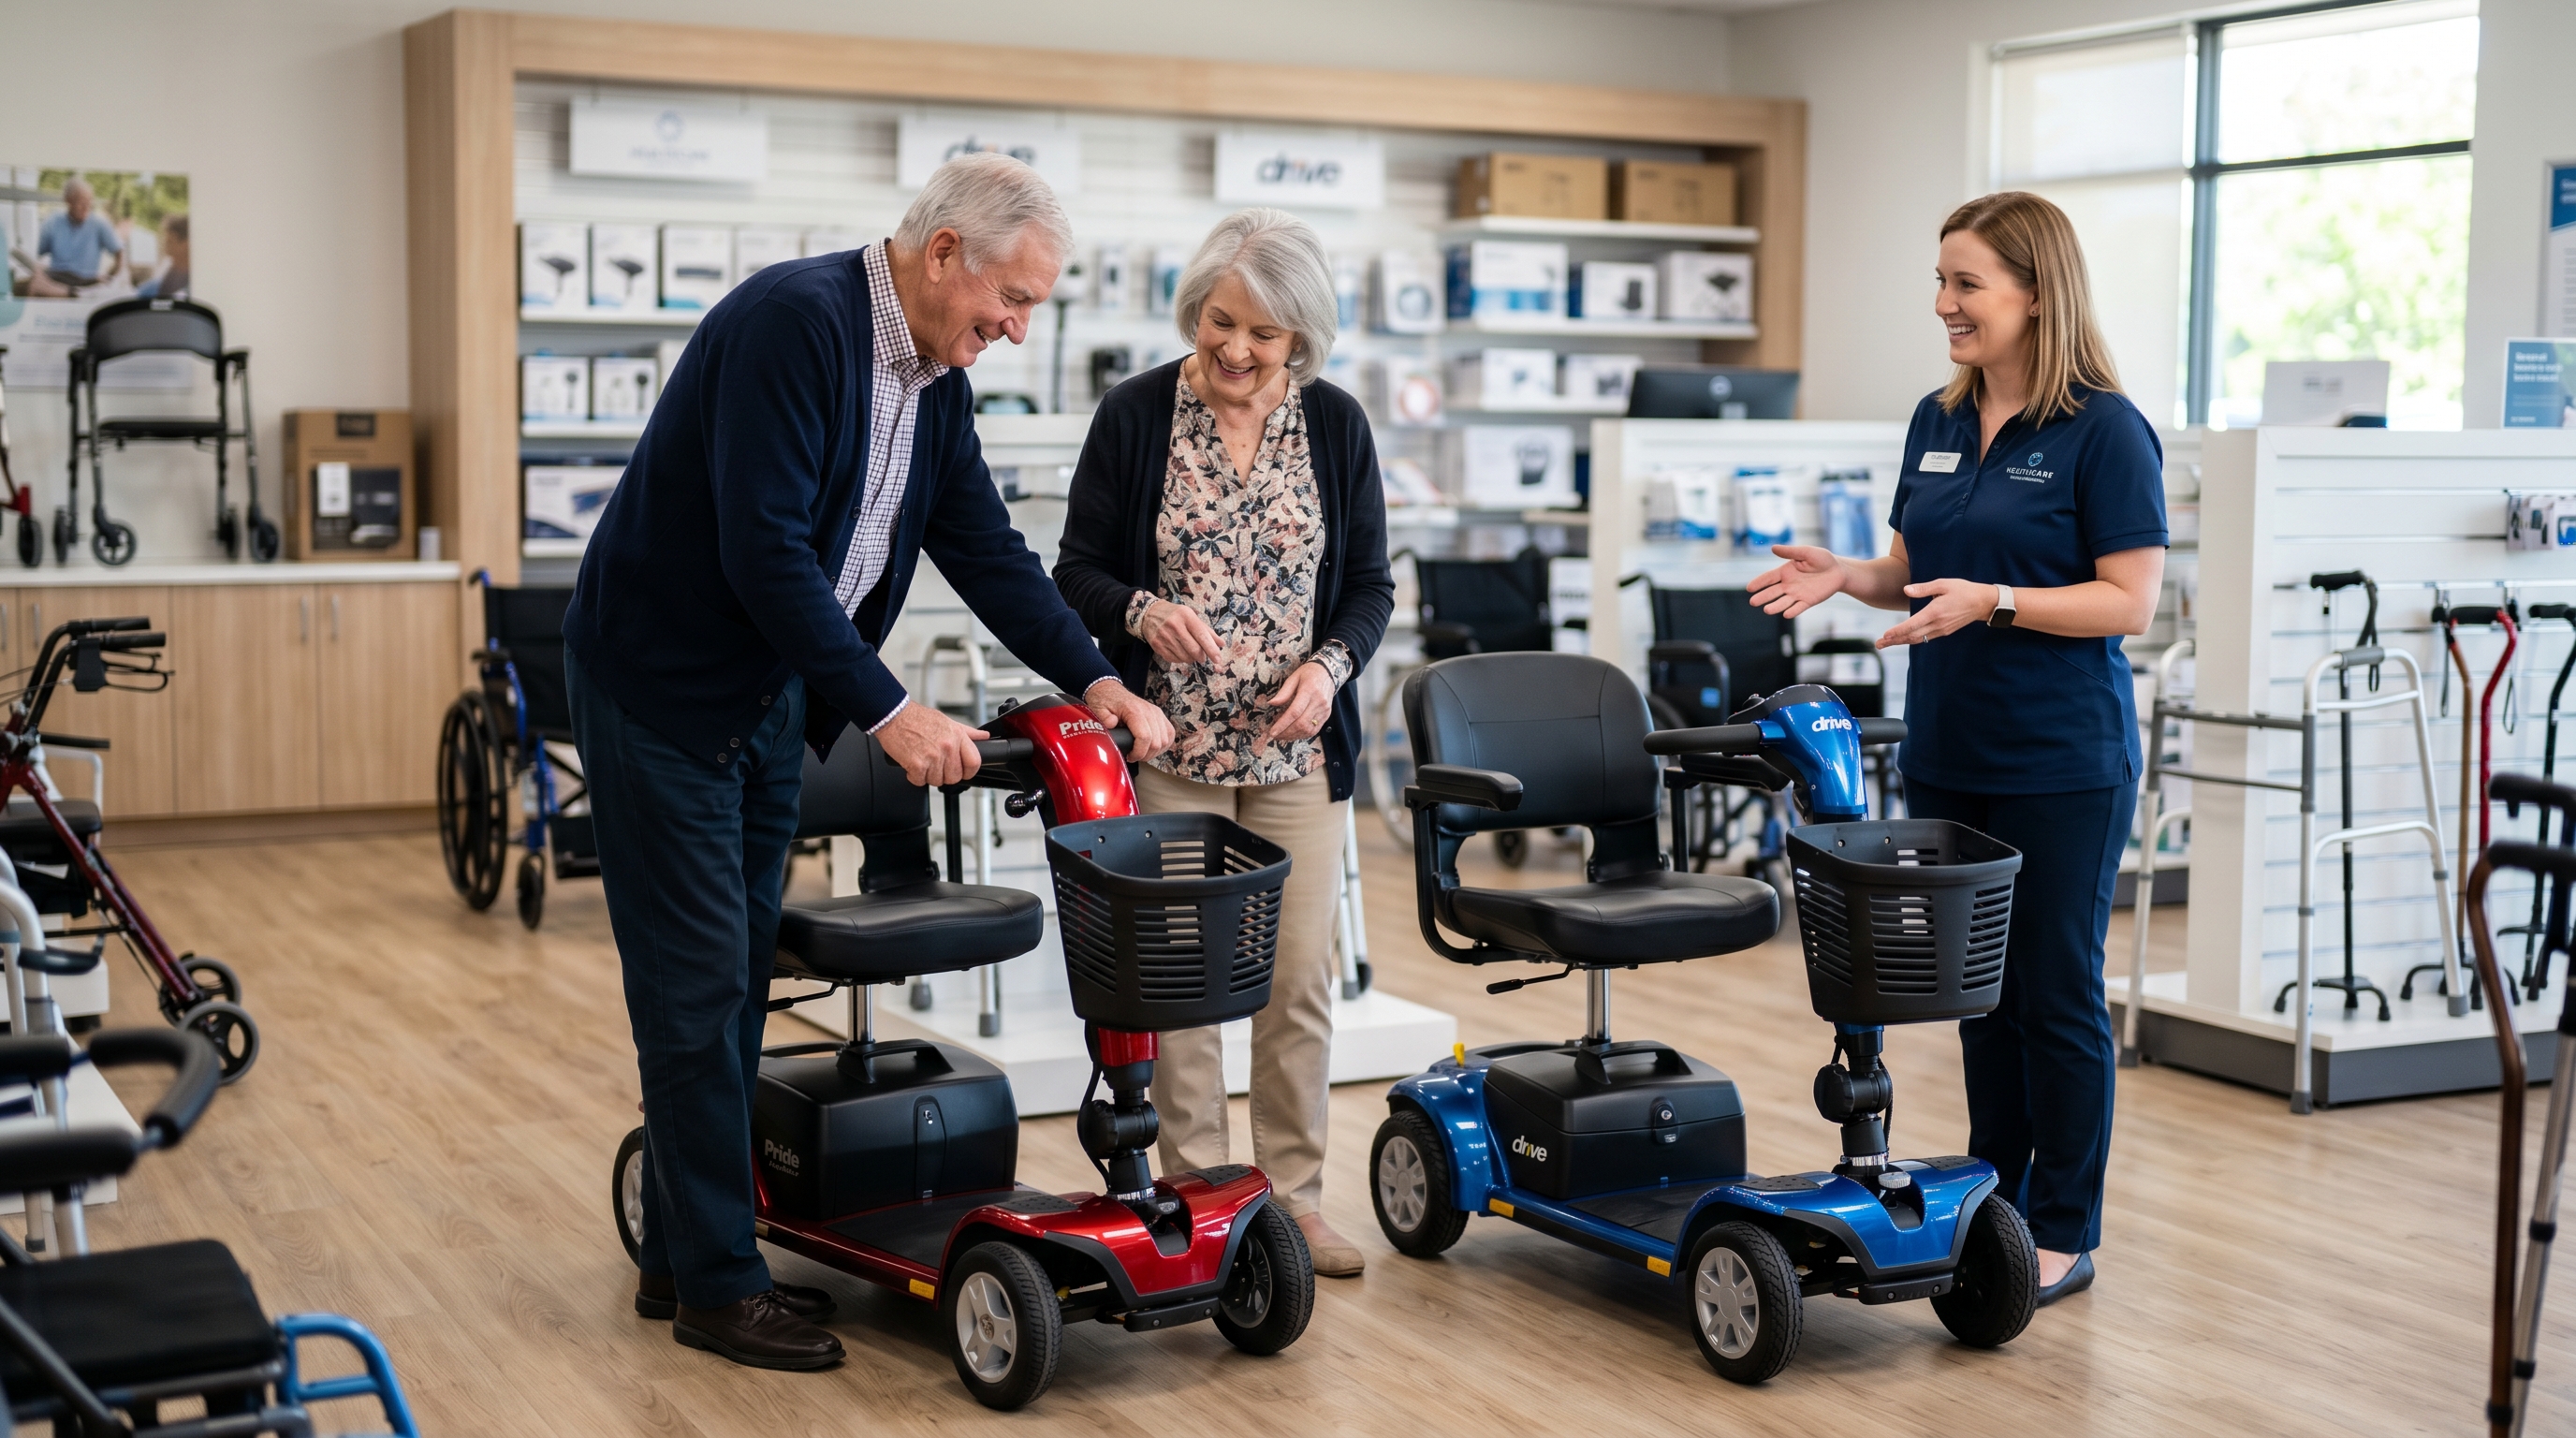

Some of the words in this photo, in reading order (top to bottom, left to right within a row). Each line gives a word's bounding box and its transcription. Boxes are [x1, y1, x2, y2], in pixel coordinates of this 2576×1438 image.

[1059, 719, 1104, 736] Pride
[1811, 716, 1852, 732] drive
[765, 1138, 799, 1168] Pride
[1512, 1135, 1547, 1162] drive
